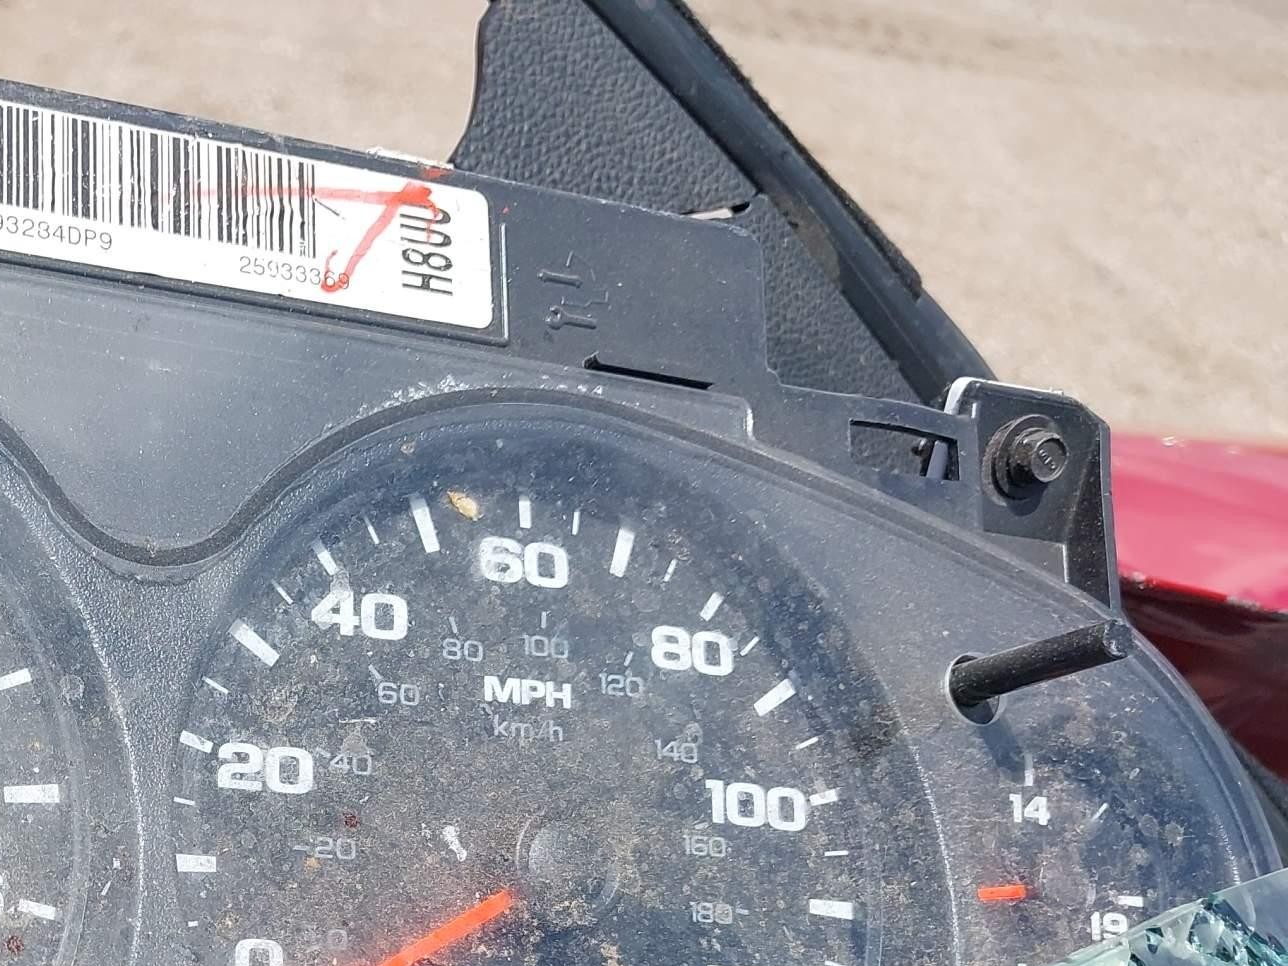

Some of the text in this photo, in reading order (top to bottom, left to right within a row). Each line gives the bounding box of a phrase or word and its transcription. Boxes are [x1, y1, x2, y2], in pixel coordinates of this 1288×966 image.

[399, 203, 454, 296] H8UU
[480, 536, 569, 588] 60
[312, 589, 409, 640] 40
[442, 638, 484, 662] 80
[523, 634, 569, 659] 100
[651, 626, 734, 676] 80
[377, 681, 420, 706] 60
[483, 675, 572, 709] MPH
[599, 672, 645, 698] 120
[493, 714, 563, 742] km/h
[329, 752, 372, 775] 40
[655, 739, 699, 764] 140
[217, 743, 314, 795] 20
[705, 779, 807, 831] 100
[1009, 793, 1050, 826] 14
[313, 836, 356, 860] 20
[682, 834, 727, 858] 160
[689, 901, 733, 924] 180
[1090, 911, 1128, 941] 19
